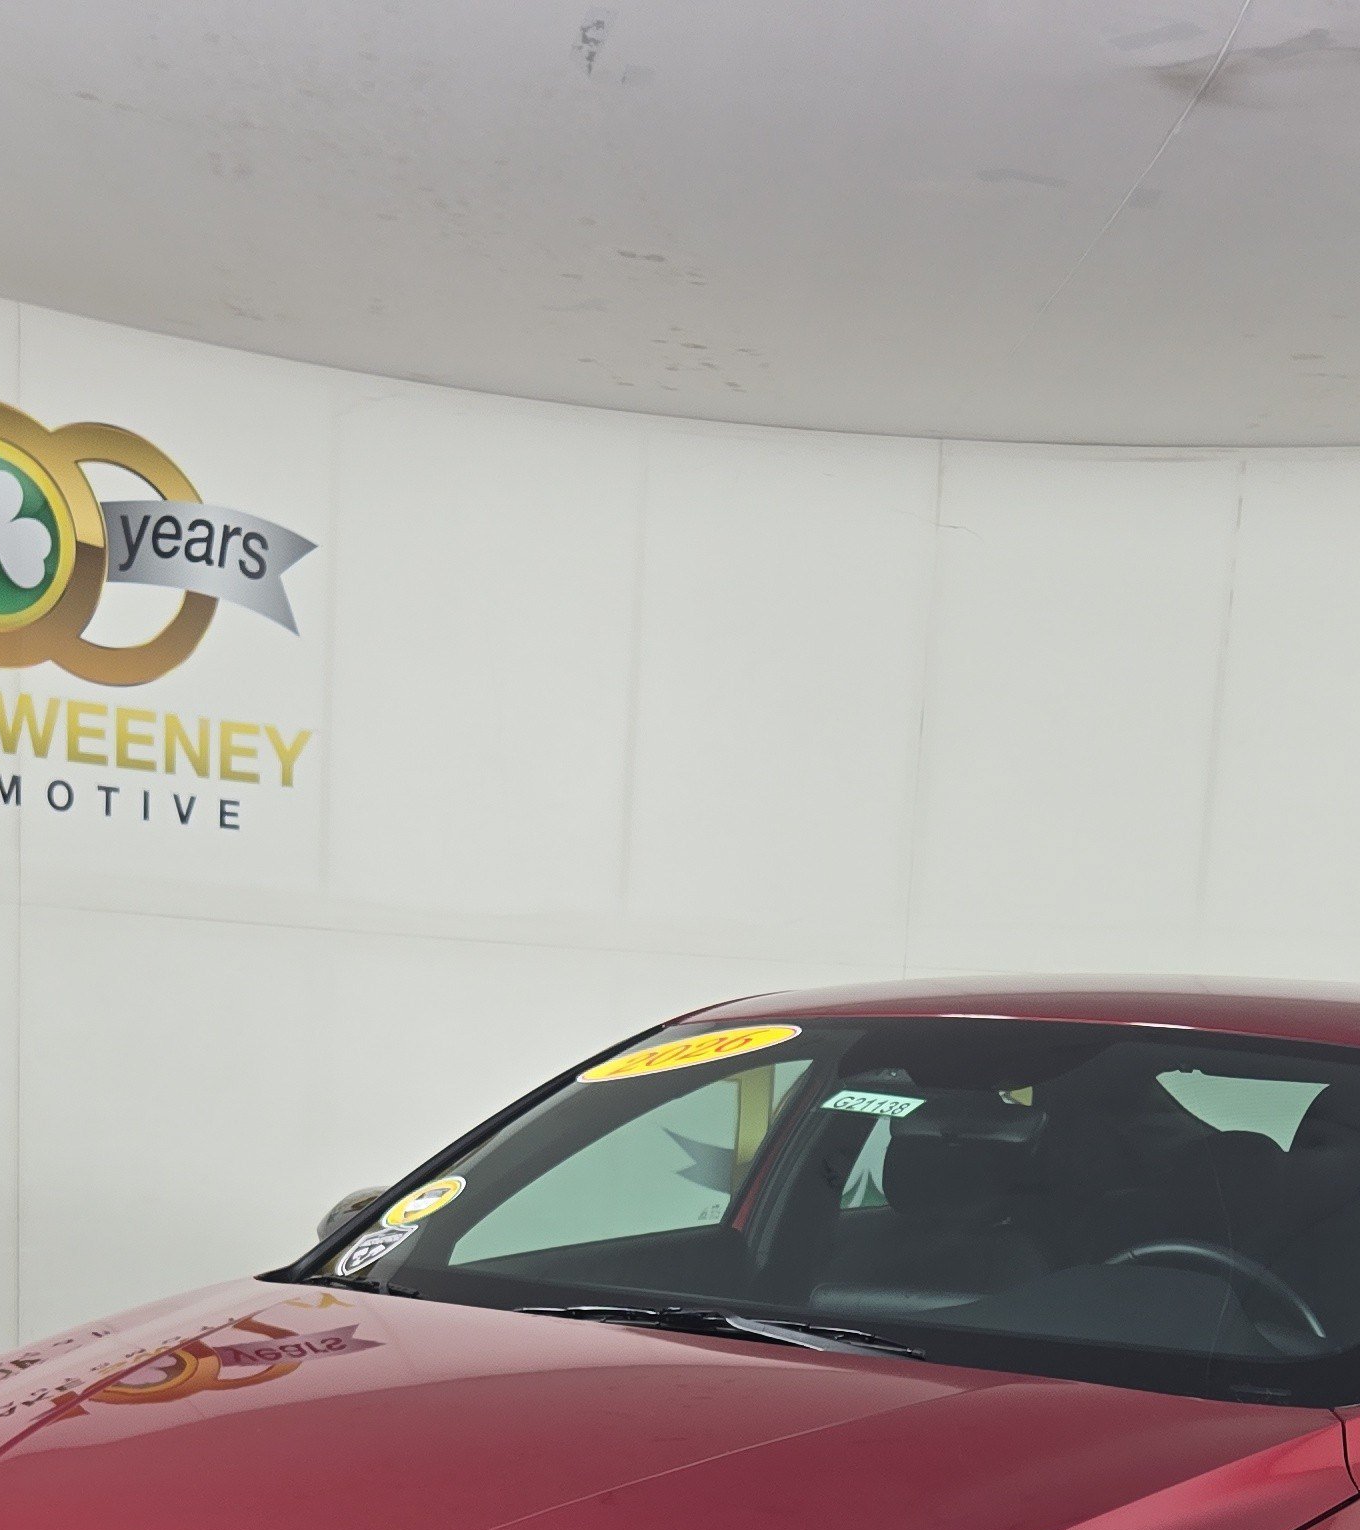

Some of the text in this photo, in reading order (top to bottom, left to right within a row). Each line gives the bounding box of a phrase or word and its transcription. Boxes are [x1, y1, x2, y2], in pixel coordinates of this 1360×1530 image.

[118, 512, 271, 582] years
[607, 1030, 770, 1075] 2026
[833, 1096, 911, 1115] G21138
